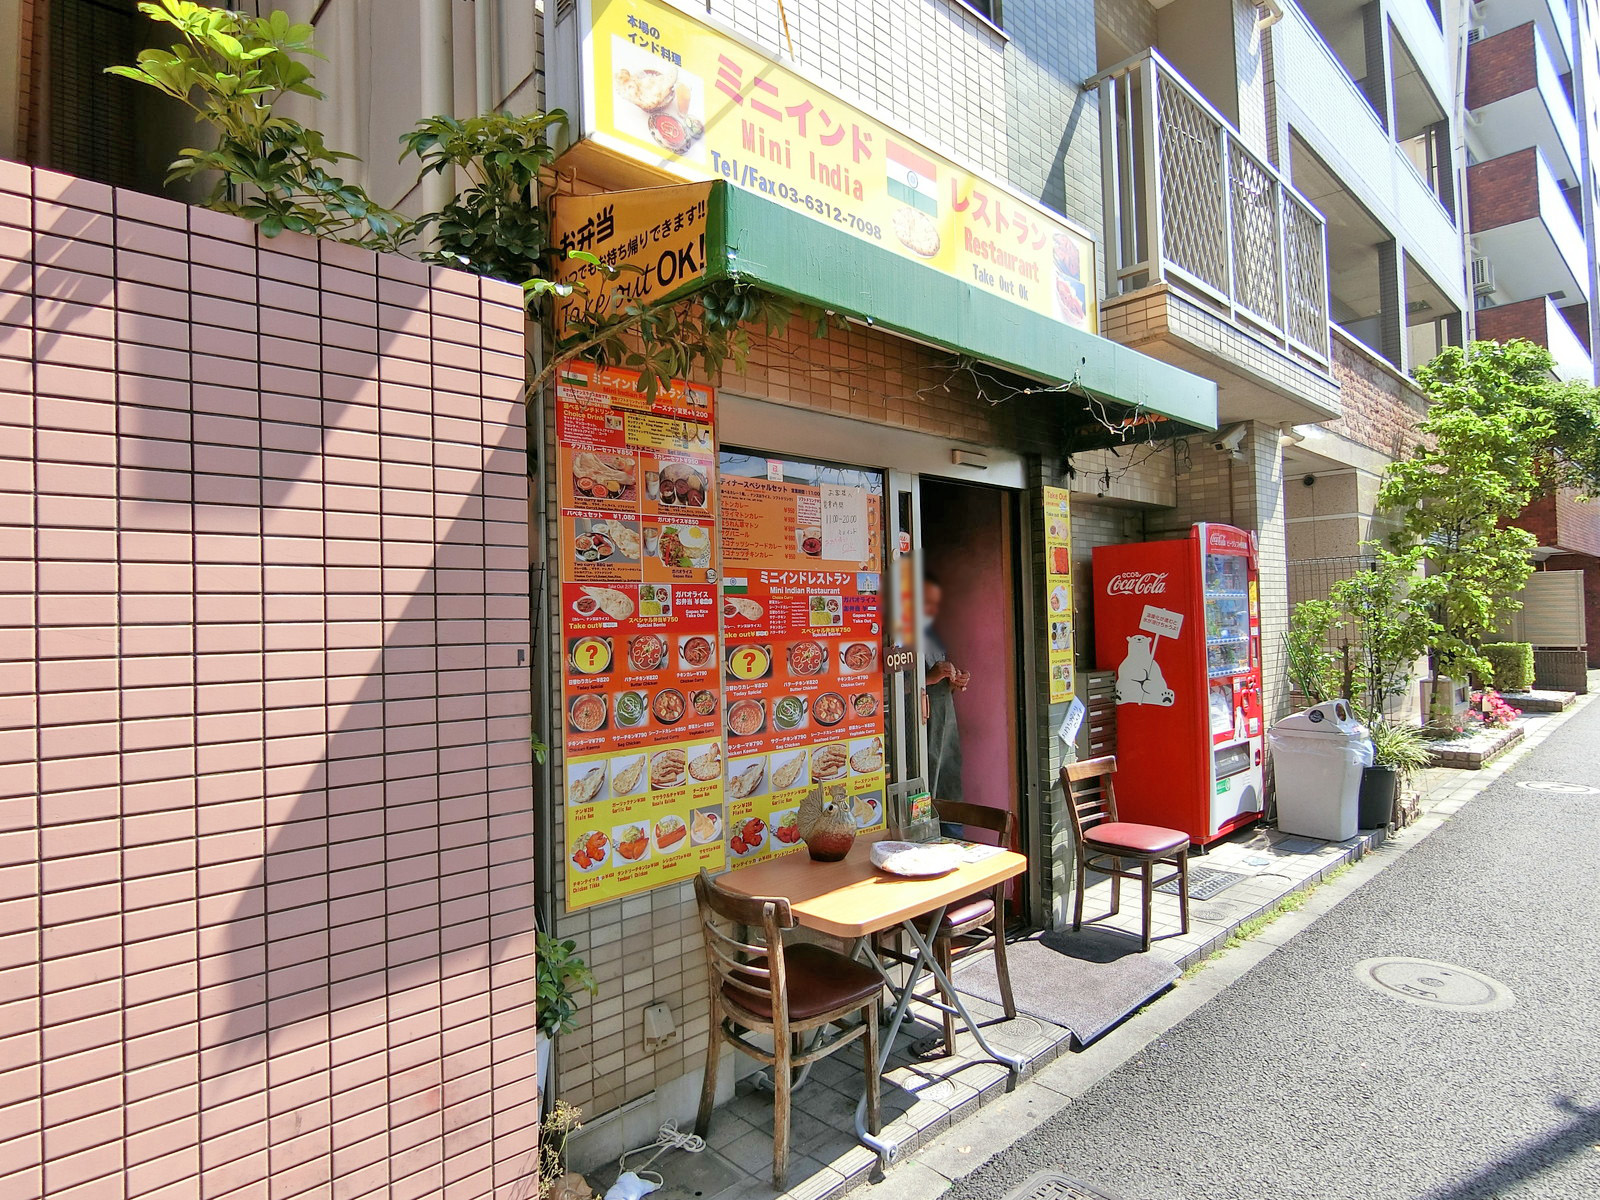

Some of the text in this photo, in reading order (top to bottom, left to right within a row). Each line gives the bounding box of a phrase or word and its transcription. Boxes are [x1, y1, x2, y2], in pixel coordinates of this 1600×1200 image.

[627, 14, 661, 40] 本場の
[627, 31, 682, 67] インド料理
[714, 52, 872, 164] ミニインド
[741, 119, 864, 202] Mini India
[779, 181, 883, 241] 03-6312-7098
[951, 177, 1047, 251] レストラン
[559, 203, 614, 262] お弁当
[656, 233, 706, 287] OK!
[964, 226, 1040, 284] Restaurant
[972, 263, 995, 287] Take
[999, 275, 1015, 294] Out
[563, 410, 605, 422] Choice Drink
[759, 570, 851, 585] ミニインドレストラン
[769, 586, 840, 595] Mini Indian Restaurant
[1106, 571, 1169, 596] Coca-Cola
[724, 630, 742, 638] ake
[887, 651, 914, 671] open
